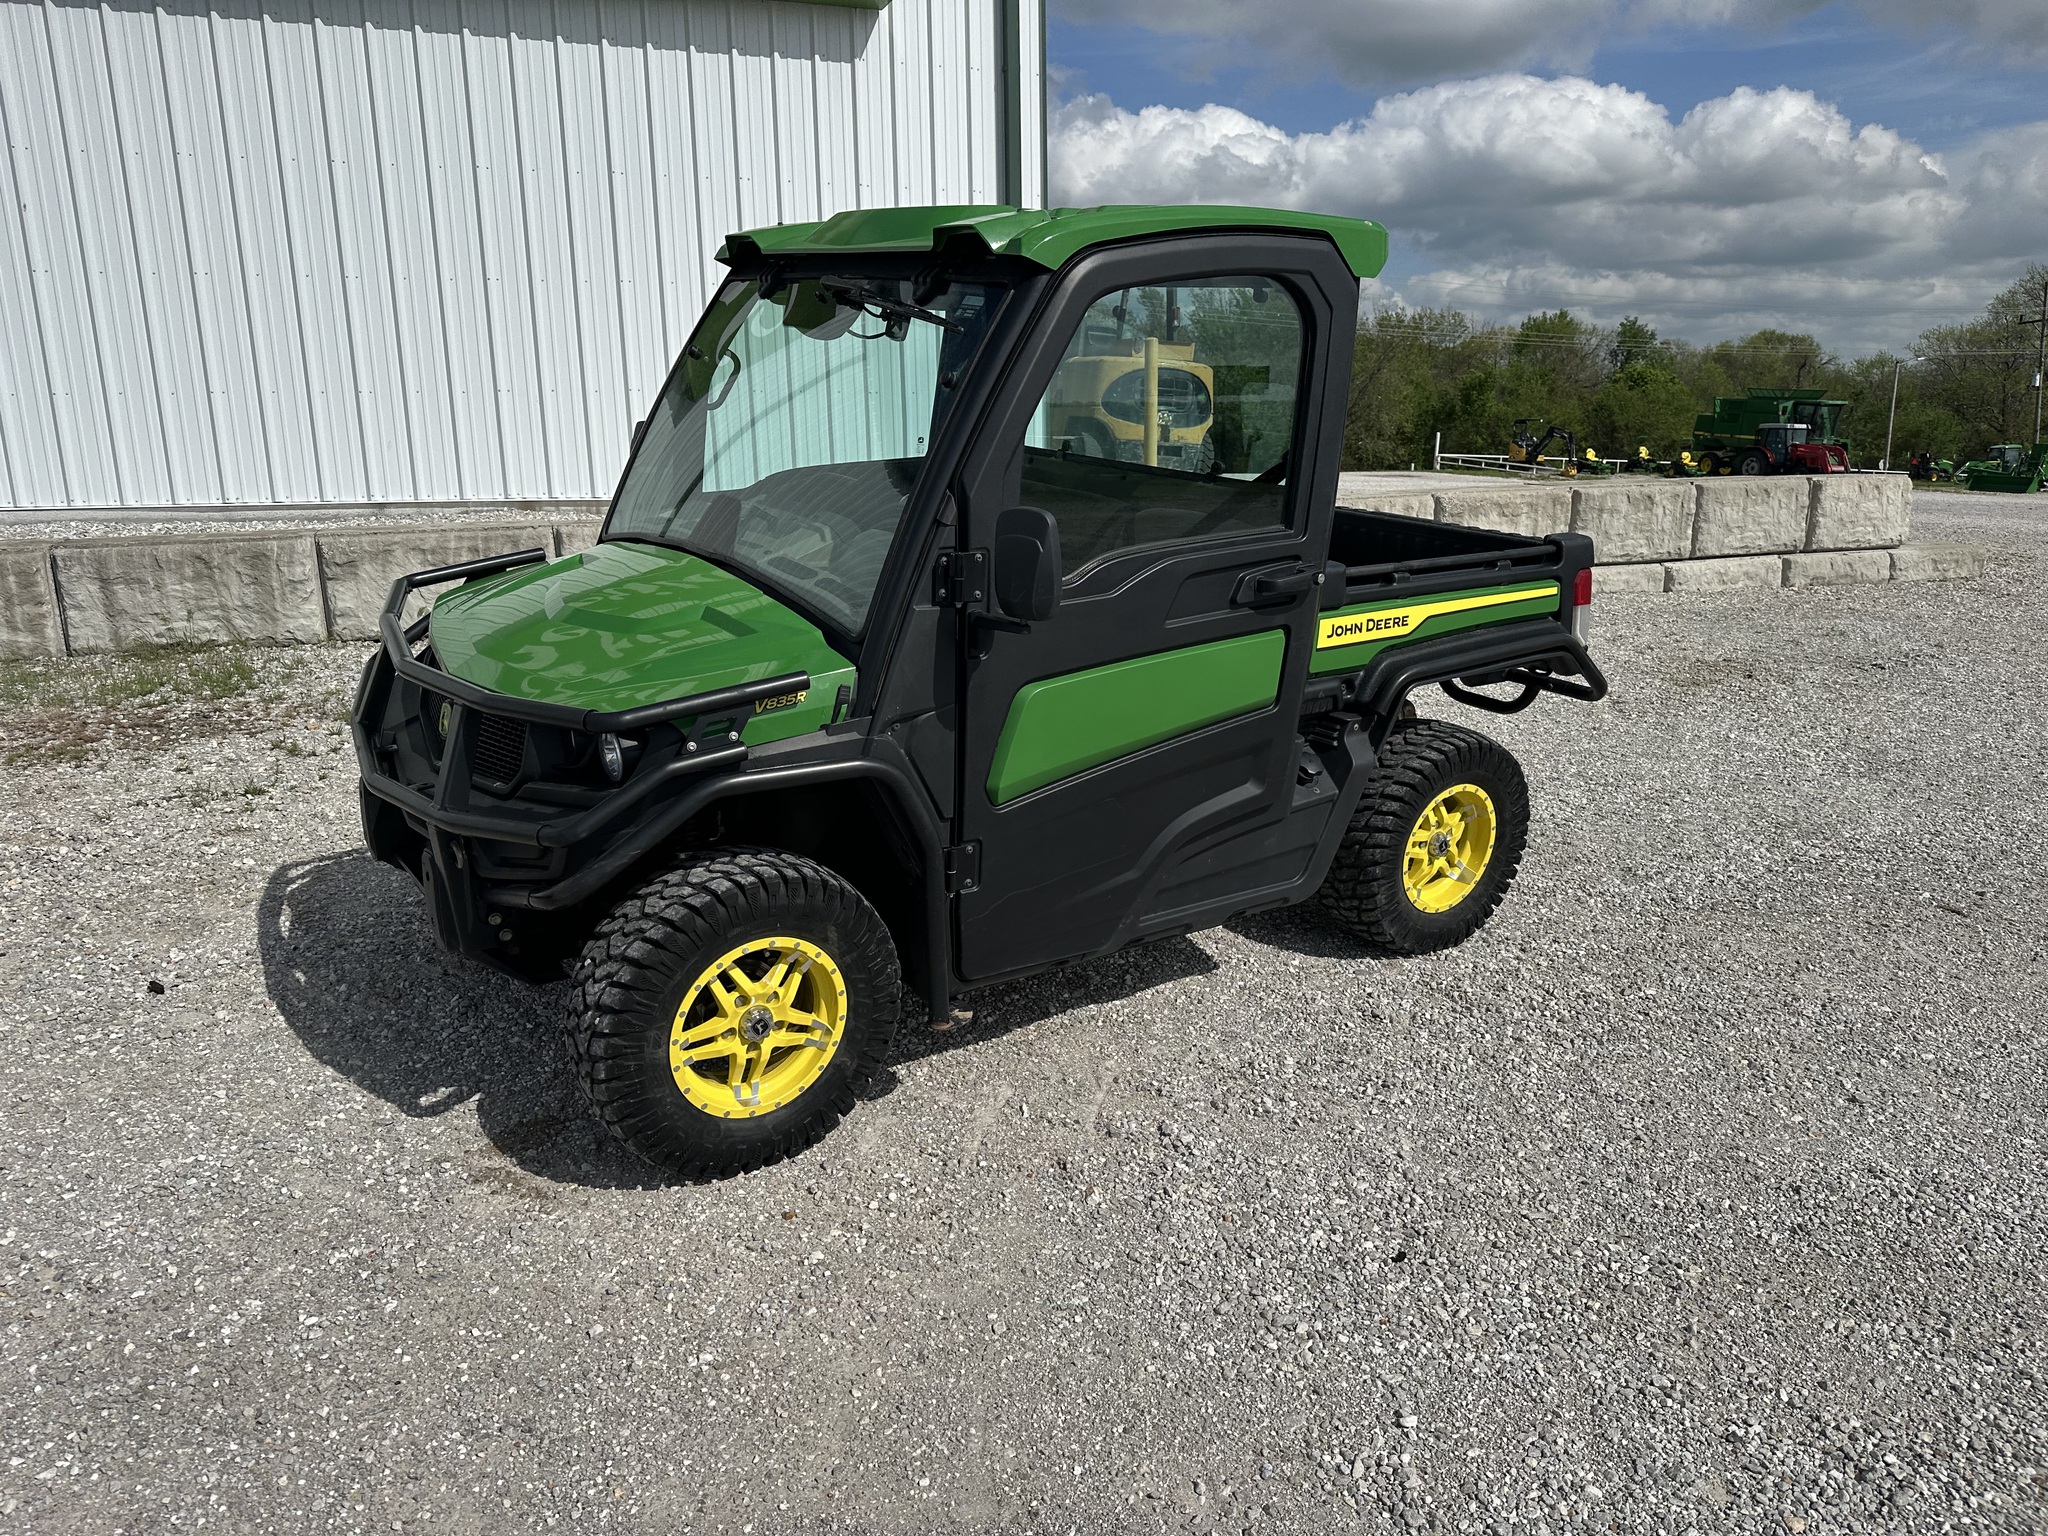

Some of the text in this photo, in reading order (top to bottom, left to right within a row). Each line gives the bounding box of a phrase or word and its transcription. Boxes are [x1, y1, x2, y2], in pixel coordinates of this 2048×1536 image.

[1327, 616, 1410, 639] JOHN DEERE
[754, 691, 807, 714] V835R
